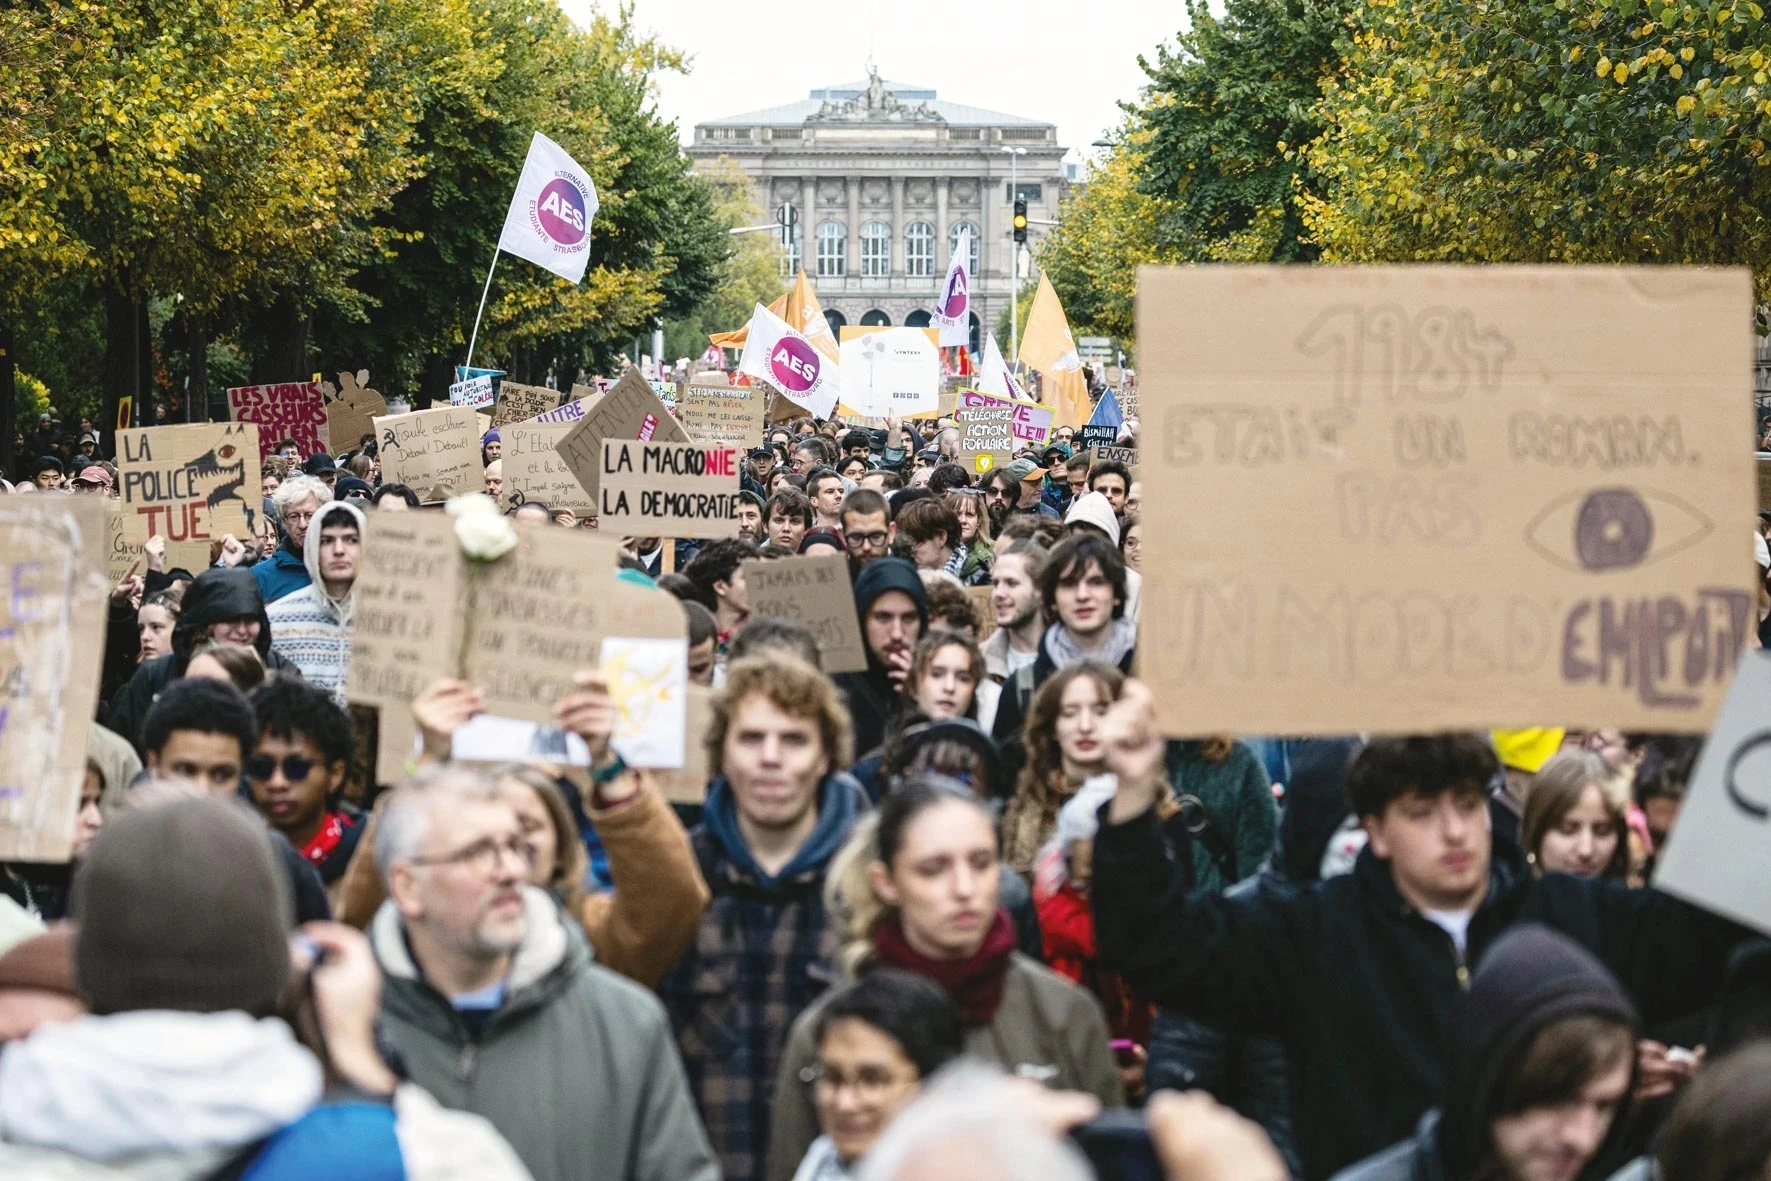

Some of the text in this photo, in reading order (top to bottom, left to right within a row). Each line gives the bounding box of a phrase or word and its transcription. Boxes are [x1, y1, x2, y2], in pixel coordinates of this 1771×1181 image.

[529, 200, 549, 244] ETUDIANTE
[540, 191, 584, 232] AES
[772, 347, 816, 382] AES
[1294, 301, 1517, 410] 1984
[231, 382, 322, 407] LES VRAIS
[237, 401, 327, 425] CASSEURS
[395, 413, 467, 443] Foule esclave
[707, 412, 717, 420] NE
[960, 407, 1012, 421] TÉLÉCHARGE
[124, 433, 152, 463] LA
[1391, 409, 1466, 469] UN
[1506, 409, 1702, 471] ROMAN.
[528, 463, 540, 474] et
[544, 460, 555, 474] la
[604, 443, 633, 474] LA
[124, 465, 201, 503] POLICE
[396, 465, 420, 483] Nous
[602, 487, 630, 516] LA
[1334, 468, 1484, 550] PAS
[137, 501, 210, 542] TUE
